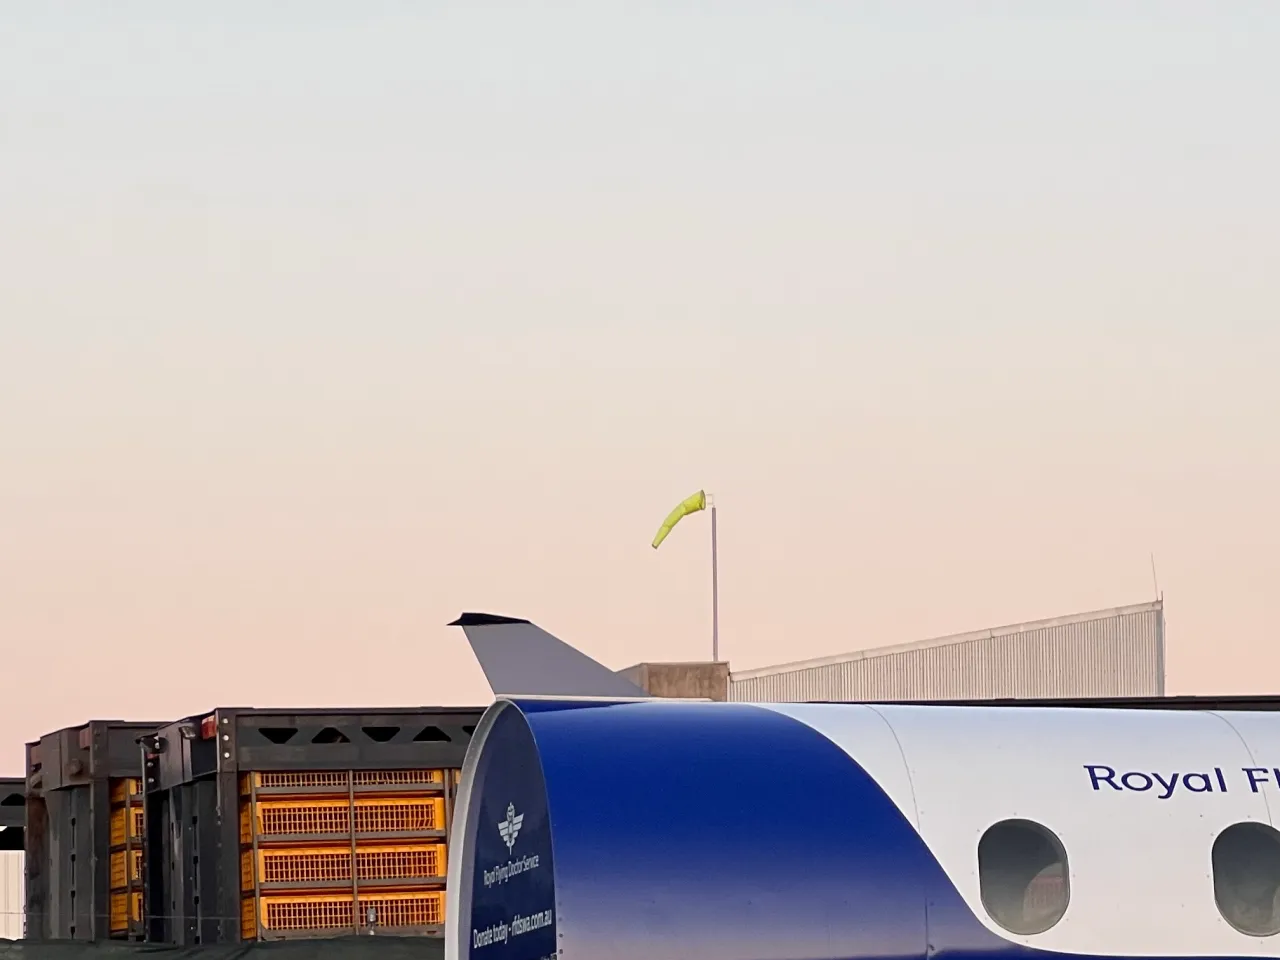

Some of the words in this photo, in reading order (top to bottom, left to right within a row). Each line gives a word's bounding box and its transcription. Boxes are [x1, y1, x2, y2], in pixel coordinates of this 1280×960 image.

[1083, 765, 1227, 799] Royal
[523, 854, 539, 871] Service
[473, 925, 492, 949] Donate
[492, 920, 508, 944] today
[512, 909, 552, 936] rfdswa.com.au
